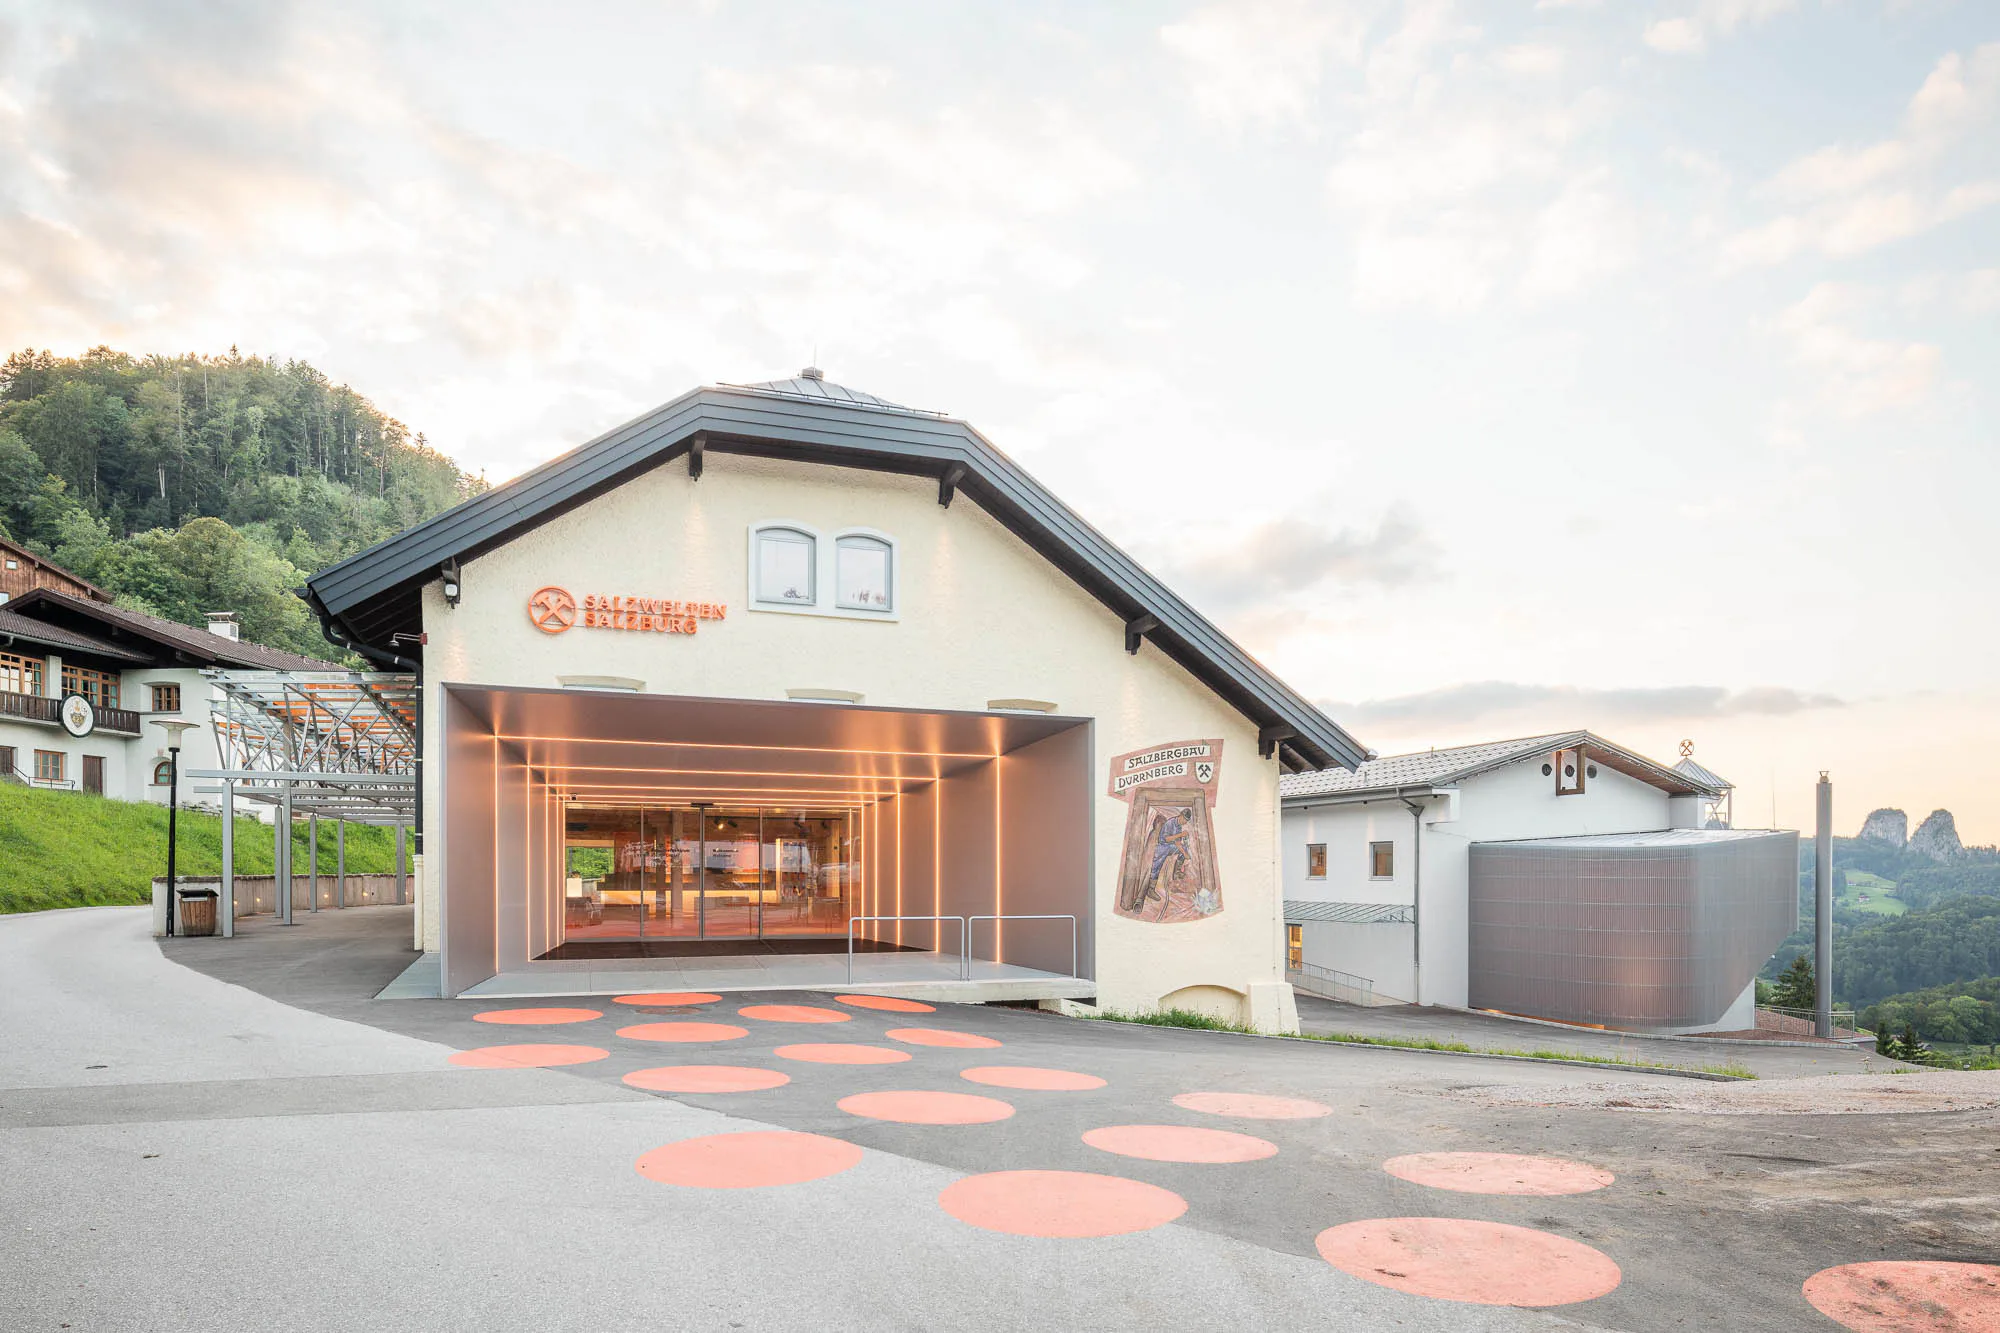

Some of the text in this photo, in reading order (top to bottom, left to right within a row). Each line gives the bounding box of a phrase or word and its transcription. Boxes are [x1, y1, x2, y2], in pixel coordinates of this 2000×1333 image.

[585, 594, 727, 620] SALZWELTEN
[585, 611, 697, 634] SALZBURG
[1128, 746, 1205, 769] SALZBERGBAU
